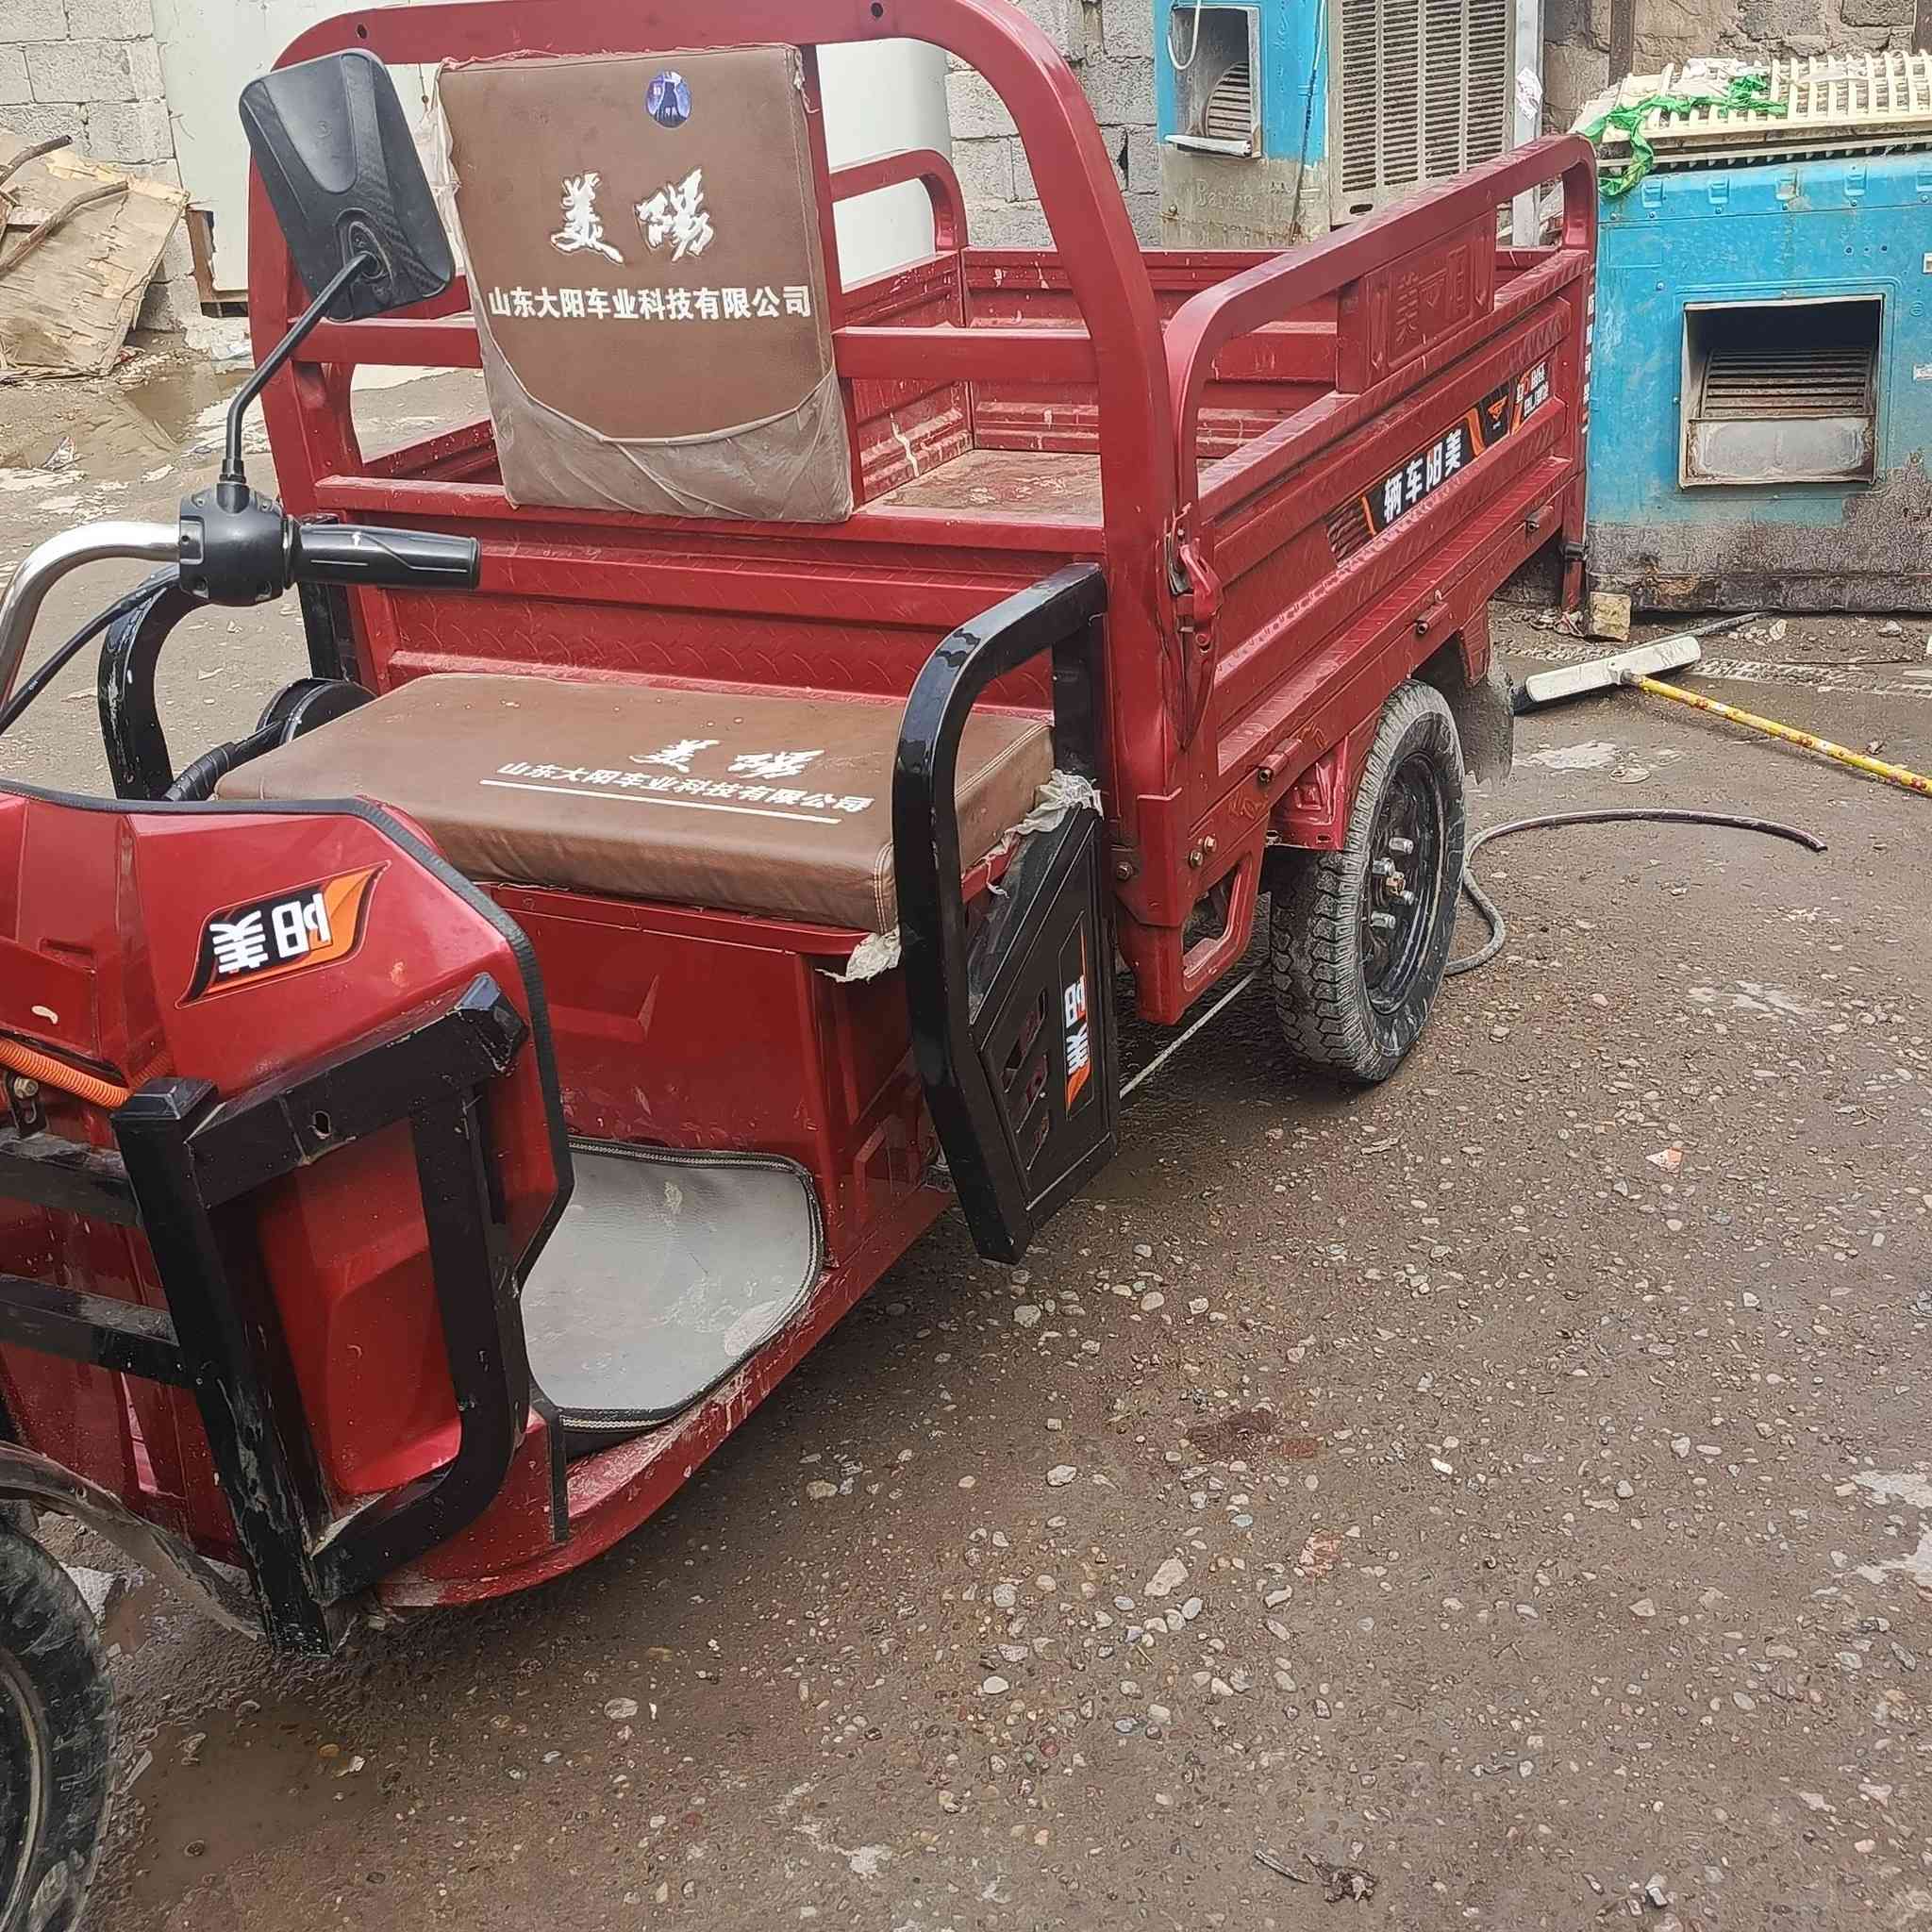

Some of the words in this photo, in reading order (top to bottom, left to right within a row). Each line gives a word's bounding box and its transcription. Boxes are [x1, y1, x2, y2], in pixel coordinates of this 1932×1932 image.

[487, 285, 813, 321] 山东大阳车业科技有限公司
[496, 761, 875, 813] 山东大阳车业科技有限公司
